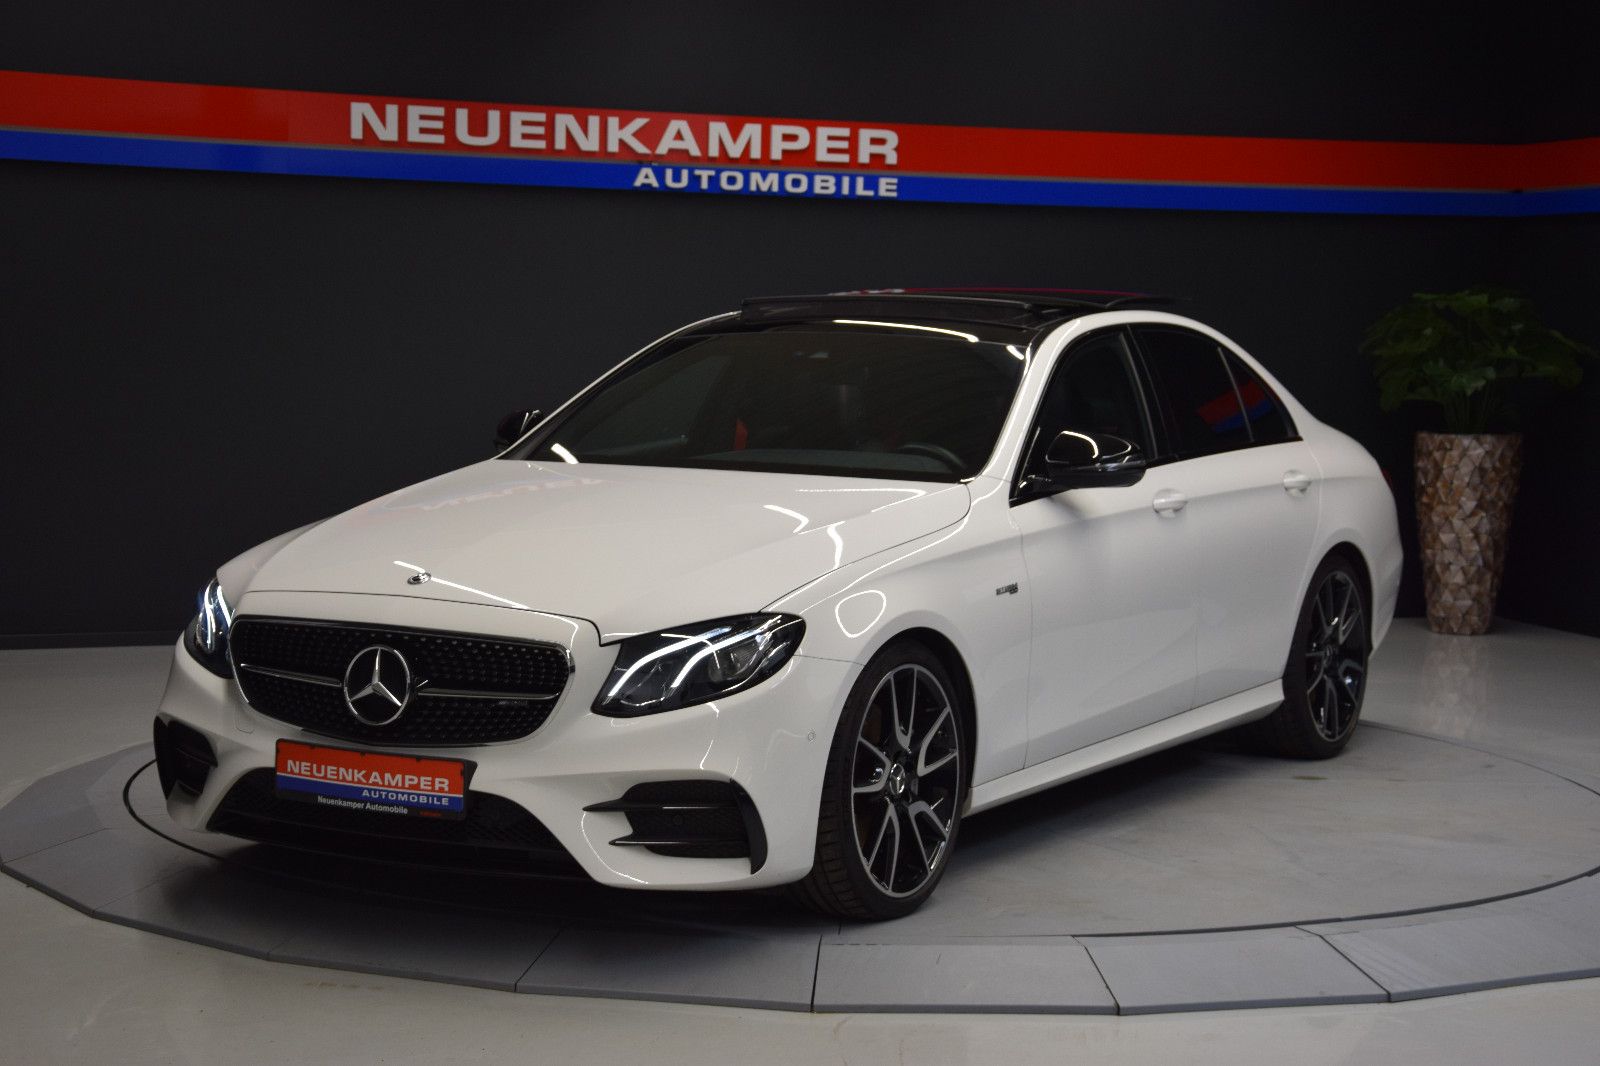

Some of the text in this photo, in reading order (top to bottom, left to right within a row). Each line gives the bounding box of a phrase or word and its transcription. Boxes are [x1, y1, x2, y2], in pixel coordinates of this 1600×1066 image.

[350, 101, 899, 166] NEUENKAMPER
[633, 166, 898, 198] AUTOMOBILE
[286, 759, 450, 792] NEUENKAMPER
[317, 795, 364, 809] Neuenkamper
[365, 802, 408, 815] Automobile
[362, 789, 449, 806] AUTOMOBILE
